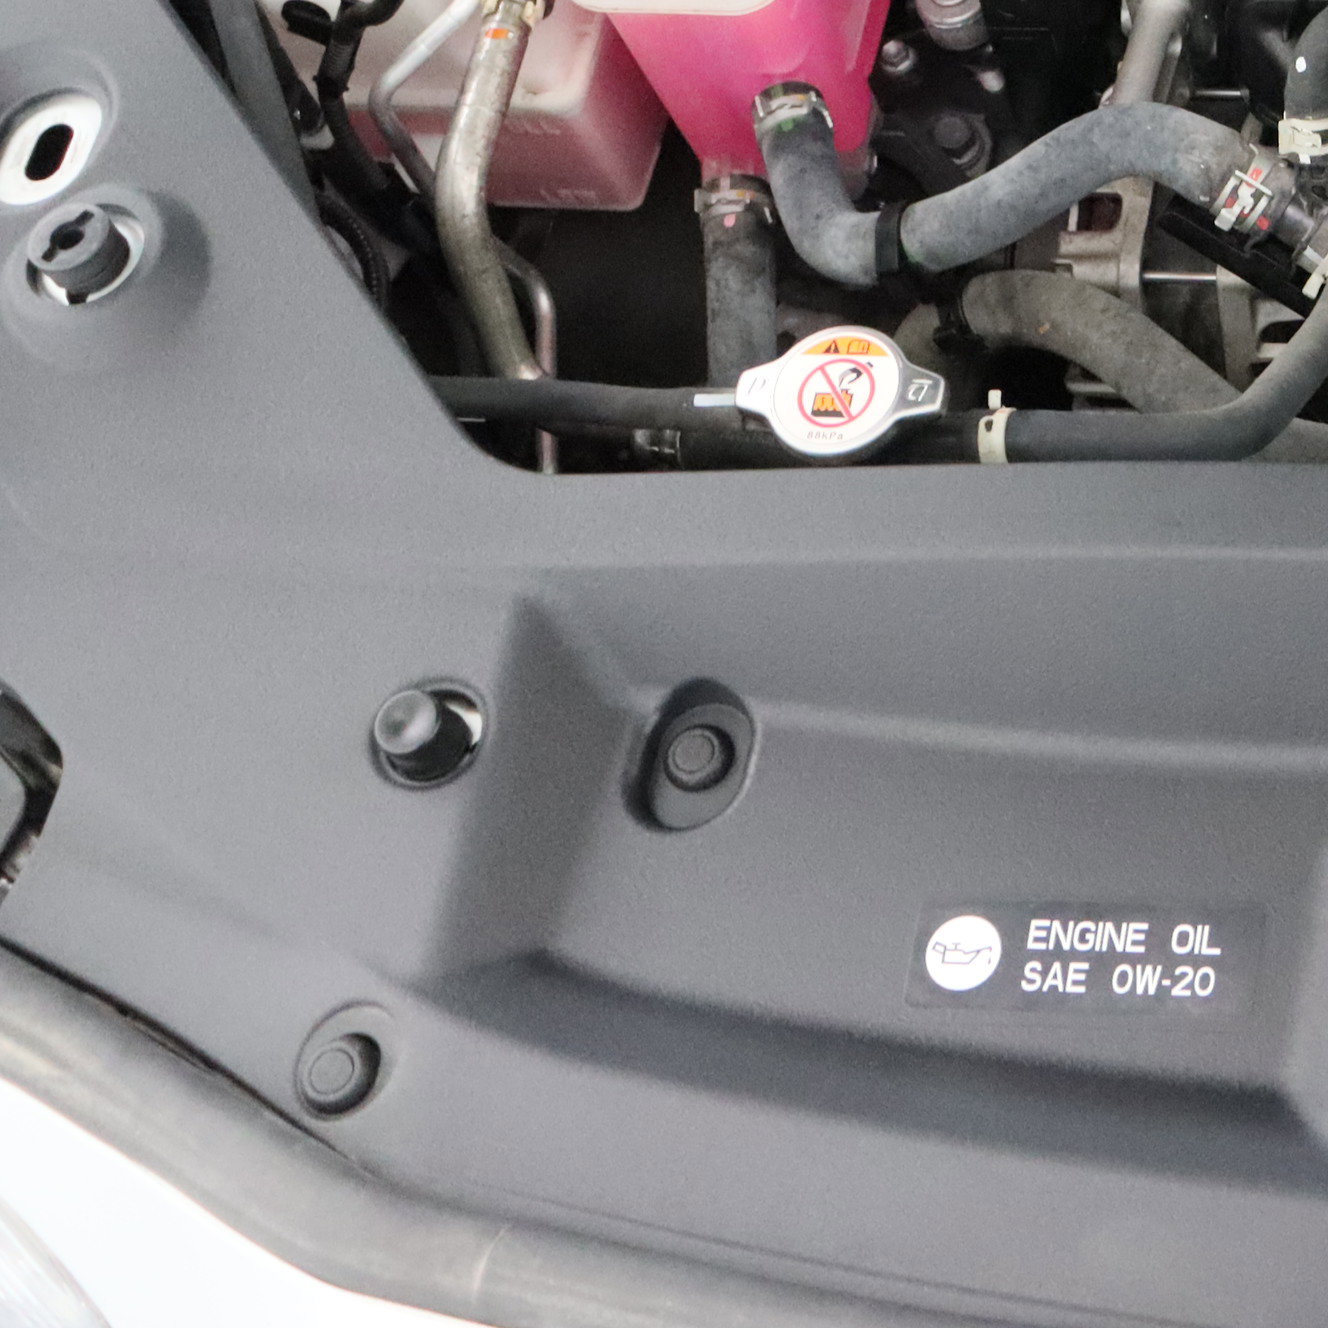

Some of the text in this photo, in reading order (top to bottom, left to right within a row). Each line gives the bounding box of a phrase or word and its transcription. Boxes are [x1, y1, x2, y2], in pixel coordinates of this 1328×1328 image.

[807, 431, 844, 440] 88kPa
[1026, 919, 1221, 955] ENGINE OIL
[1020, 960, 1216, 997] SAE 0W-20
